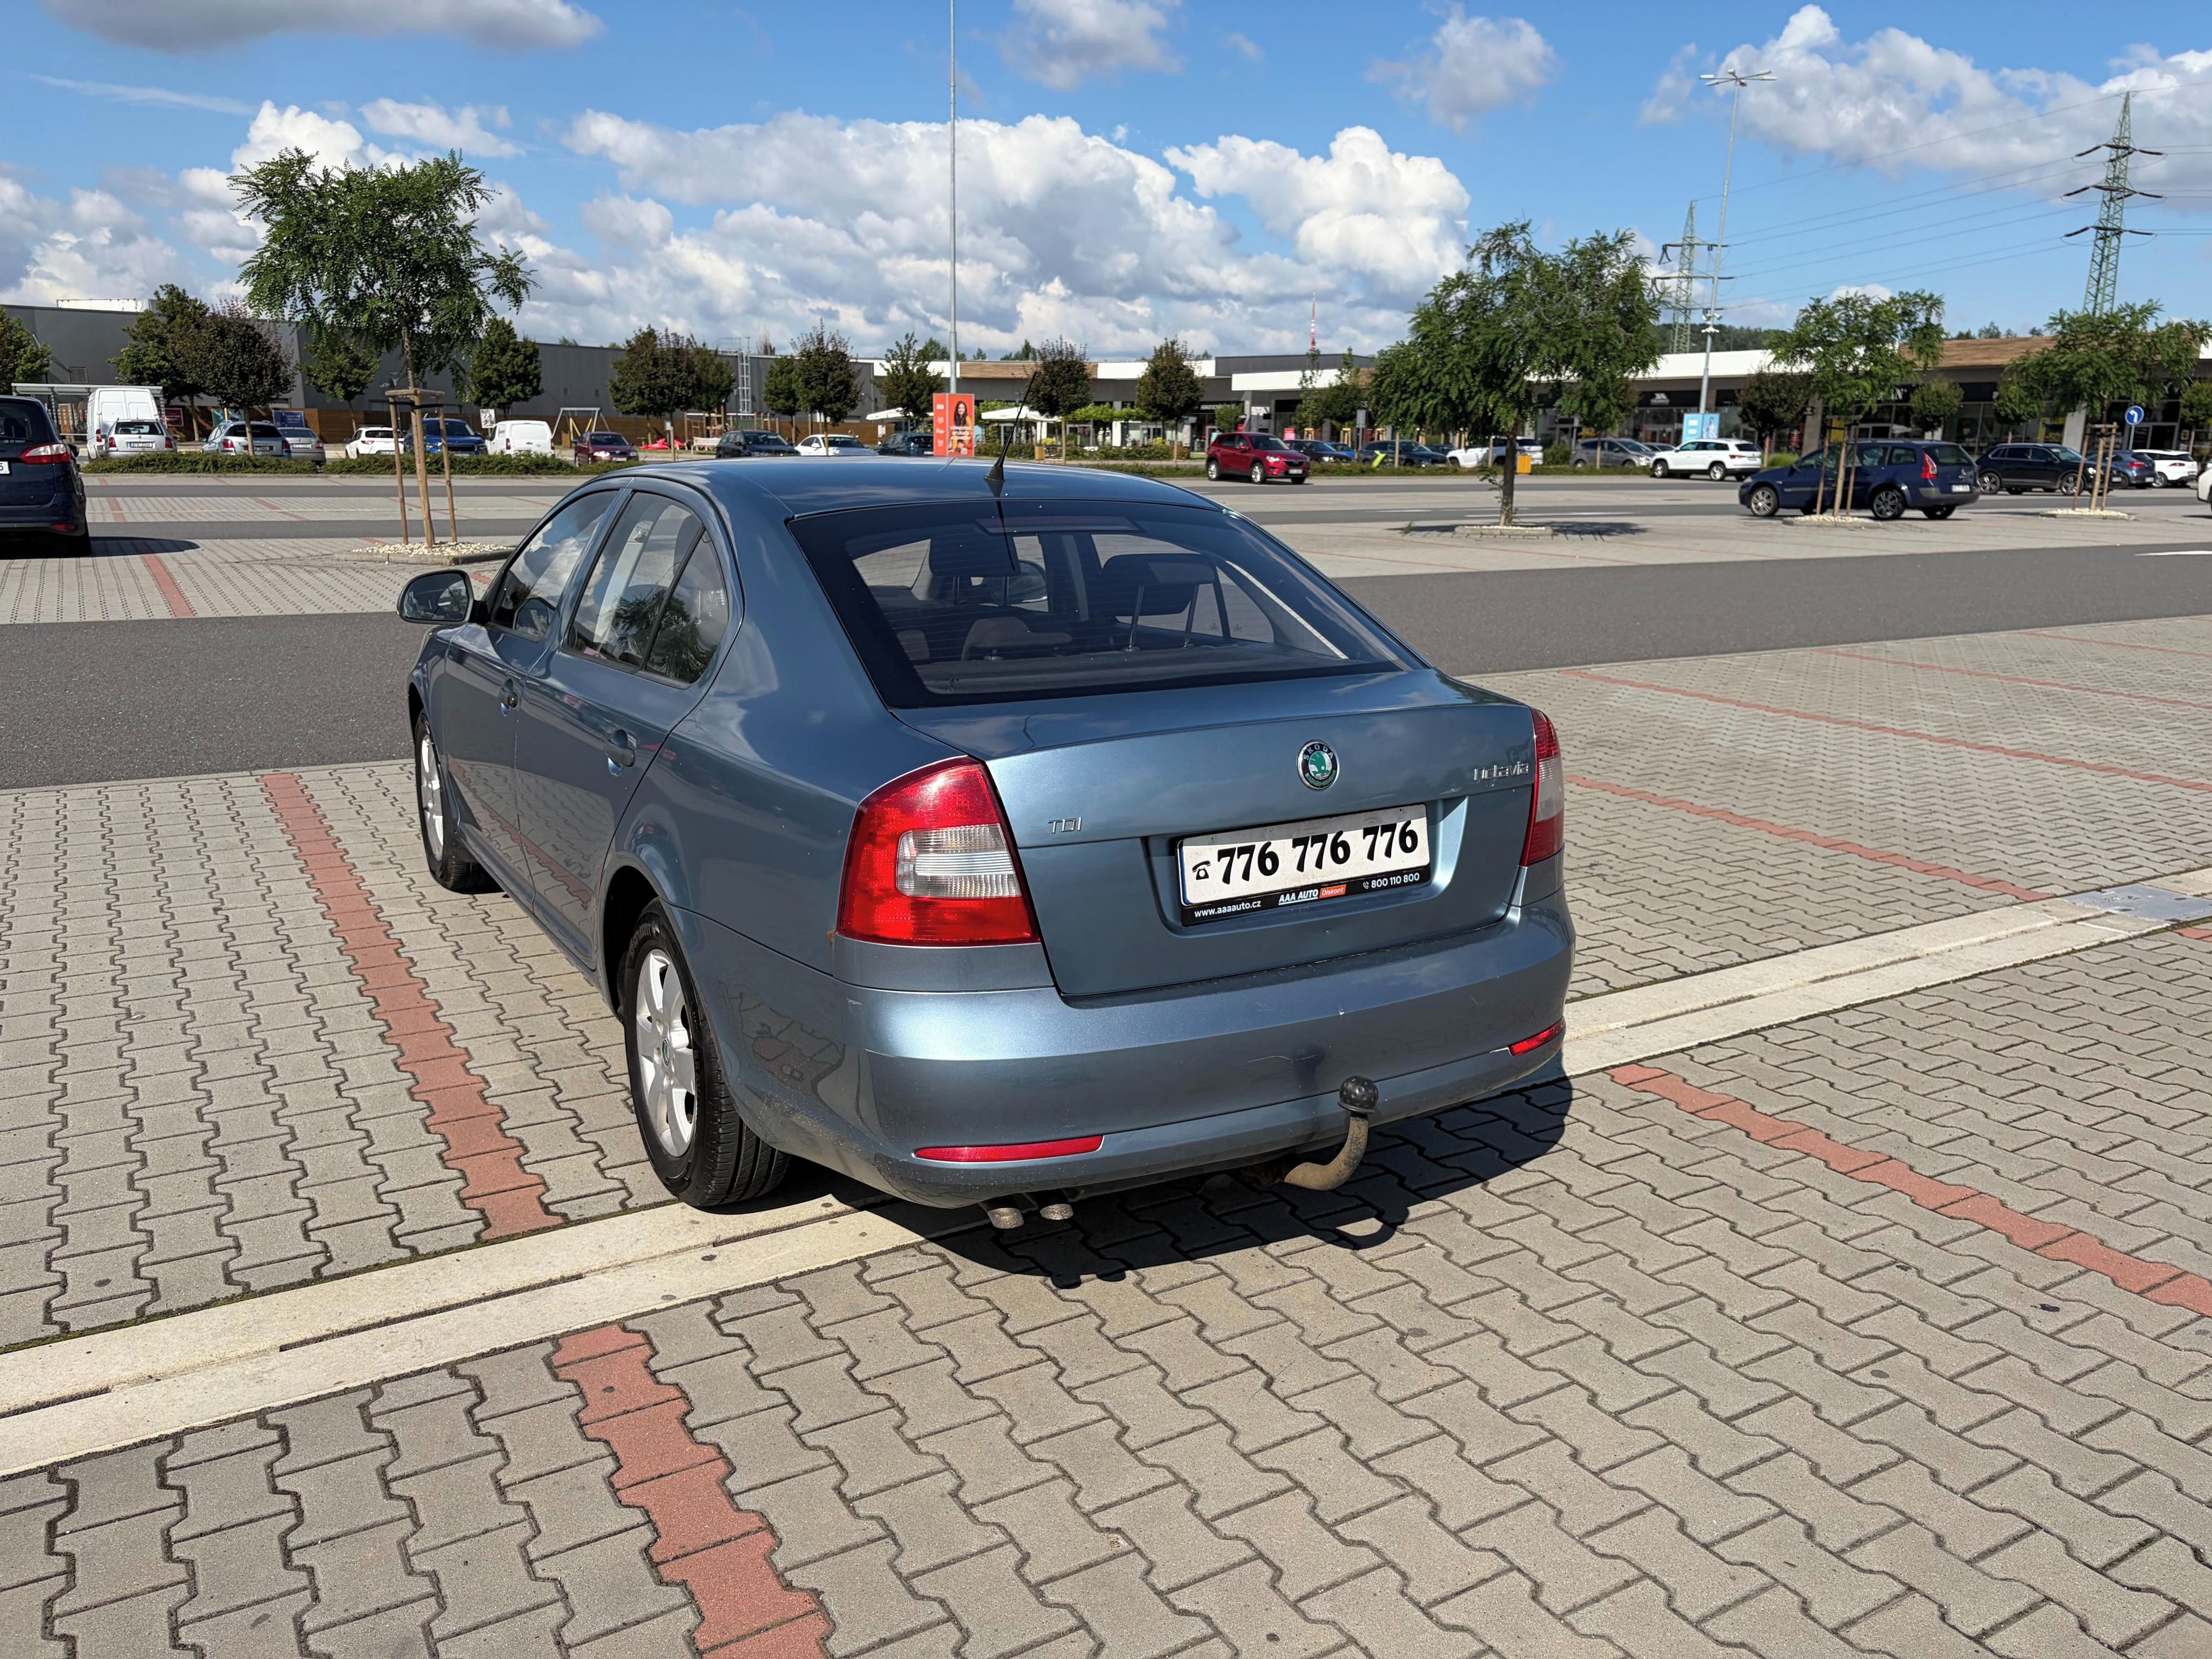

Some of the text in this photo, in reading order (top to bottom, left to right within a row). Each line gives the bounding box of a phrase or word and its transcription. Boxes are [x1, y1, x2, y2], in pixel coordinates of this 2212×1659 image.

[1473, 761, 1529, 783] Octavia
[1048, 817, 1082, 834] TDI
[1217, 820, 1419, 885] 776 776 776
[1371, 872, 1420, 888] 800 110 800
[1278, 889, 1318, 903] AAA AUTO
[1321, 887, 1344, 896] Diskont
[1194, 900, 1262, 918] www.aaaauto.cz
